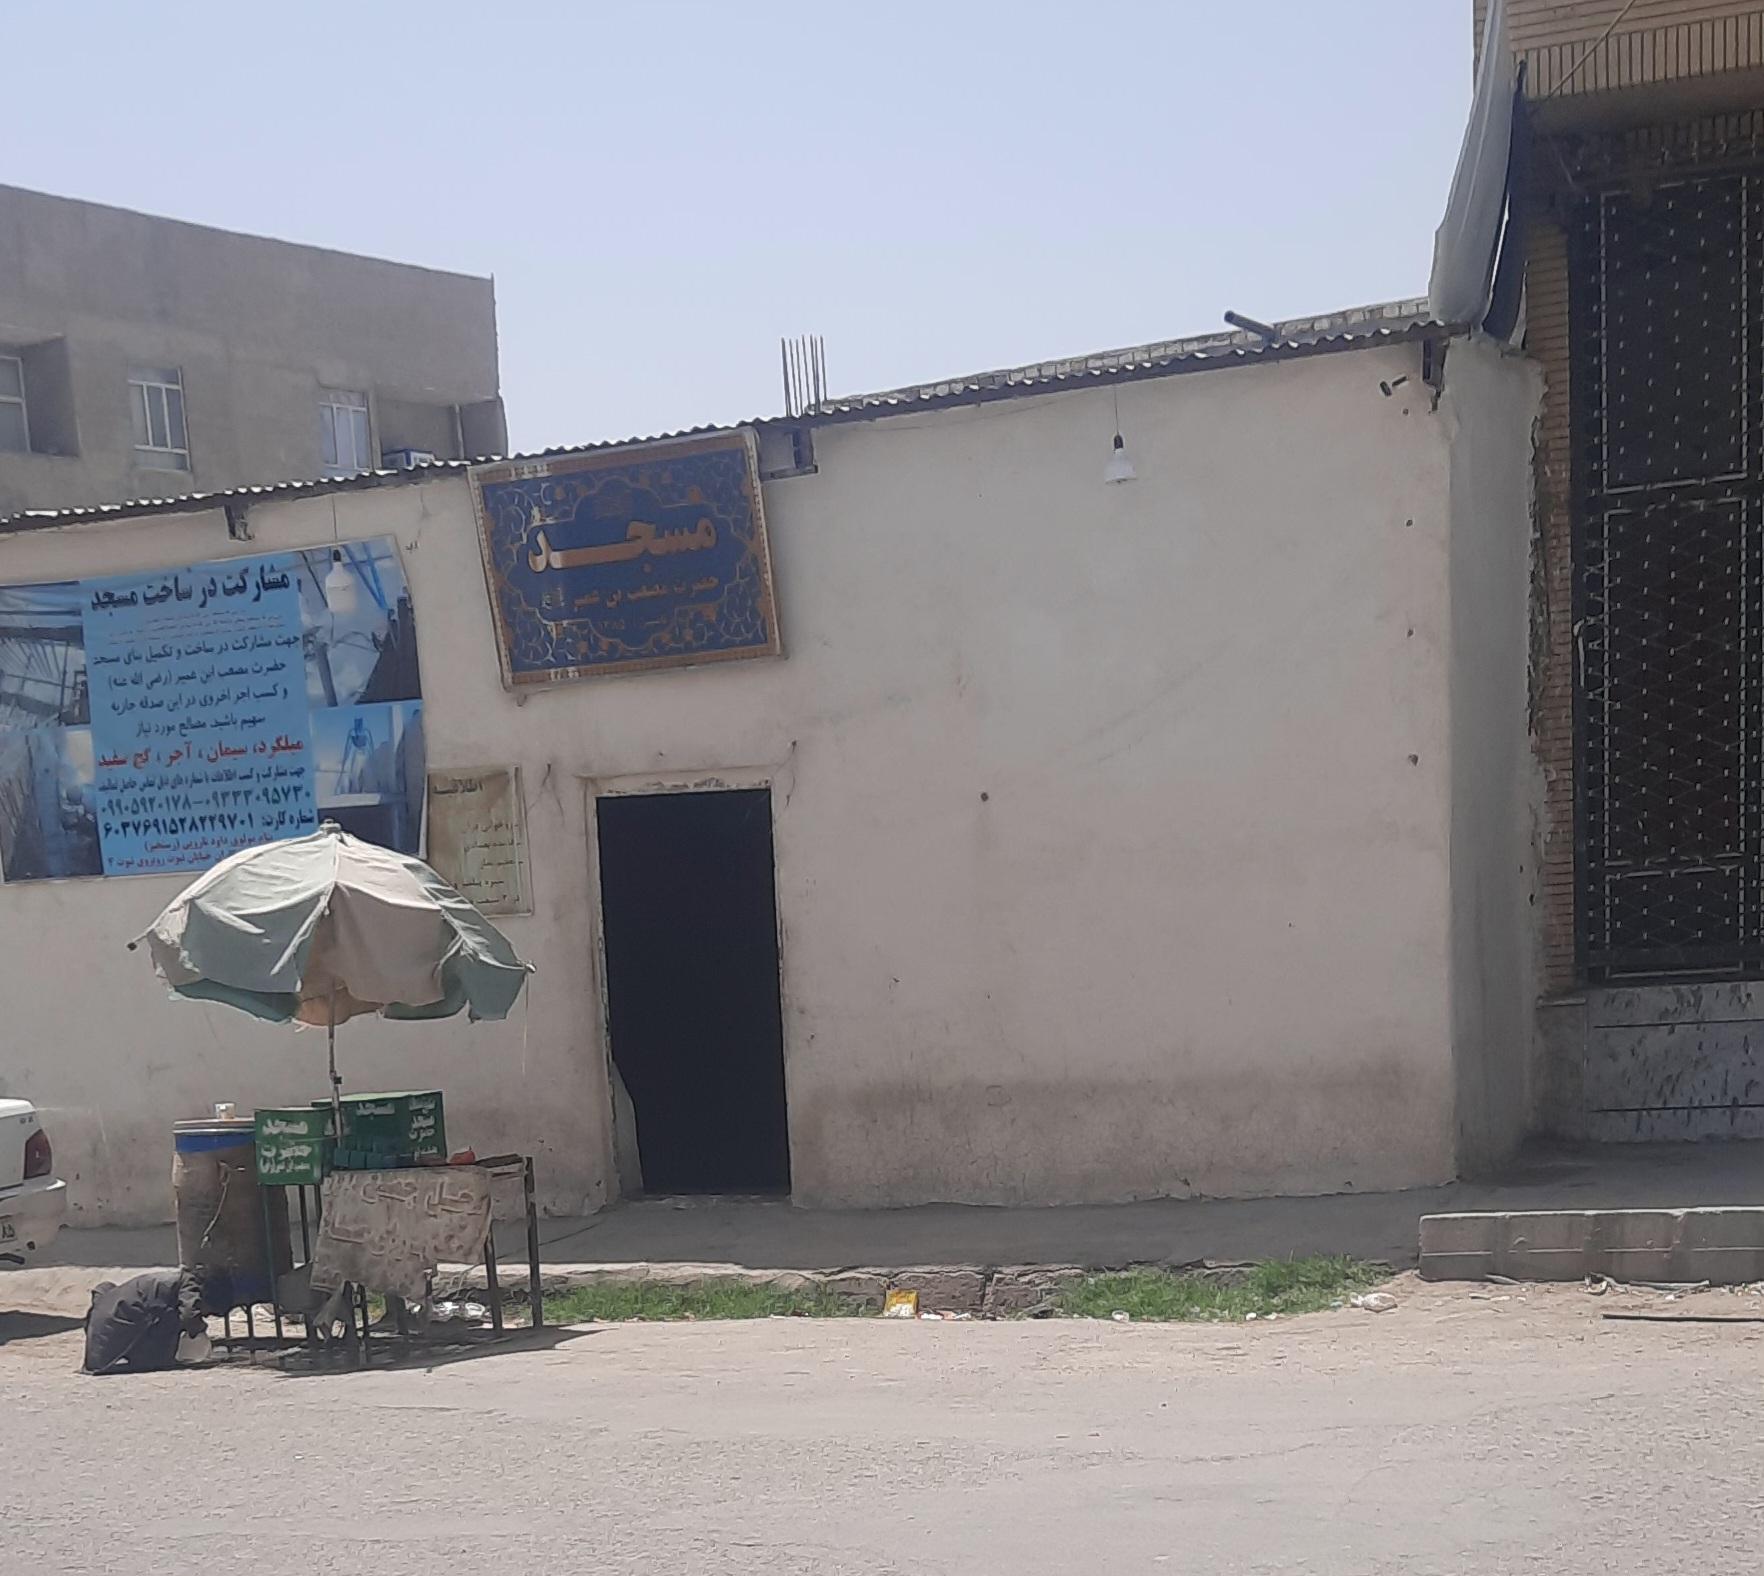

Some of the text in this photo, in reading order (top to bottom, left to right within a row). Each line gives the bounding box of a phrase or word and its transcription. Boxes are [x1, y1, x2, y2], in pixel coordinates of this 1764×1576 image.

[528, 517, 717, 574] مسجد
[91, 563, 290, 616] مشارکت در ساخت مسجد
[184, 641, 214, 656] ساخت
[217, 641, 228, 655] در
[231, 635, 272, 652] مشارکت
[275, 634, 300, 648] جهت
[145, 644, 173, 663] تکمیل
[251, 658, 286, 676] حضرت
[252, 682, 278, 699] کسب
[282, 687, 288, 700] و
[167, 693, 182, 712] این
[240, 716, 266, 731] سهیم
[289, 808, 315, 830] شماره
[262, 1119, 308, 1140] مسجد
